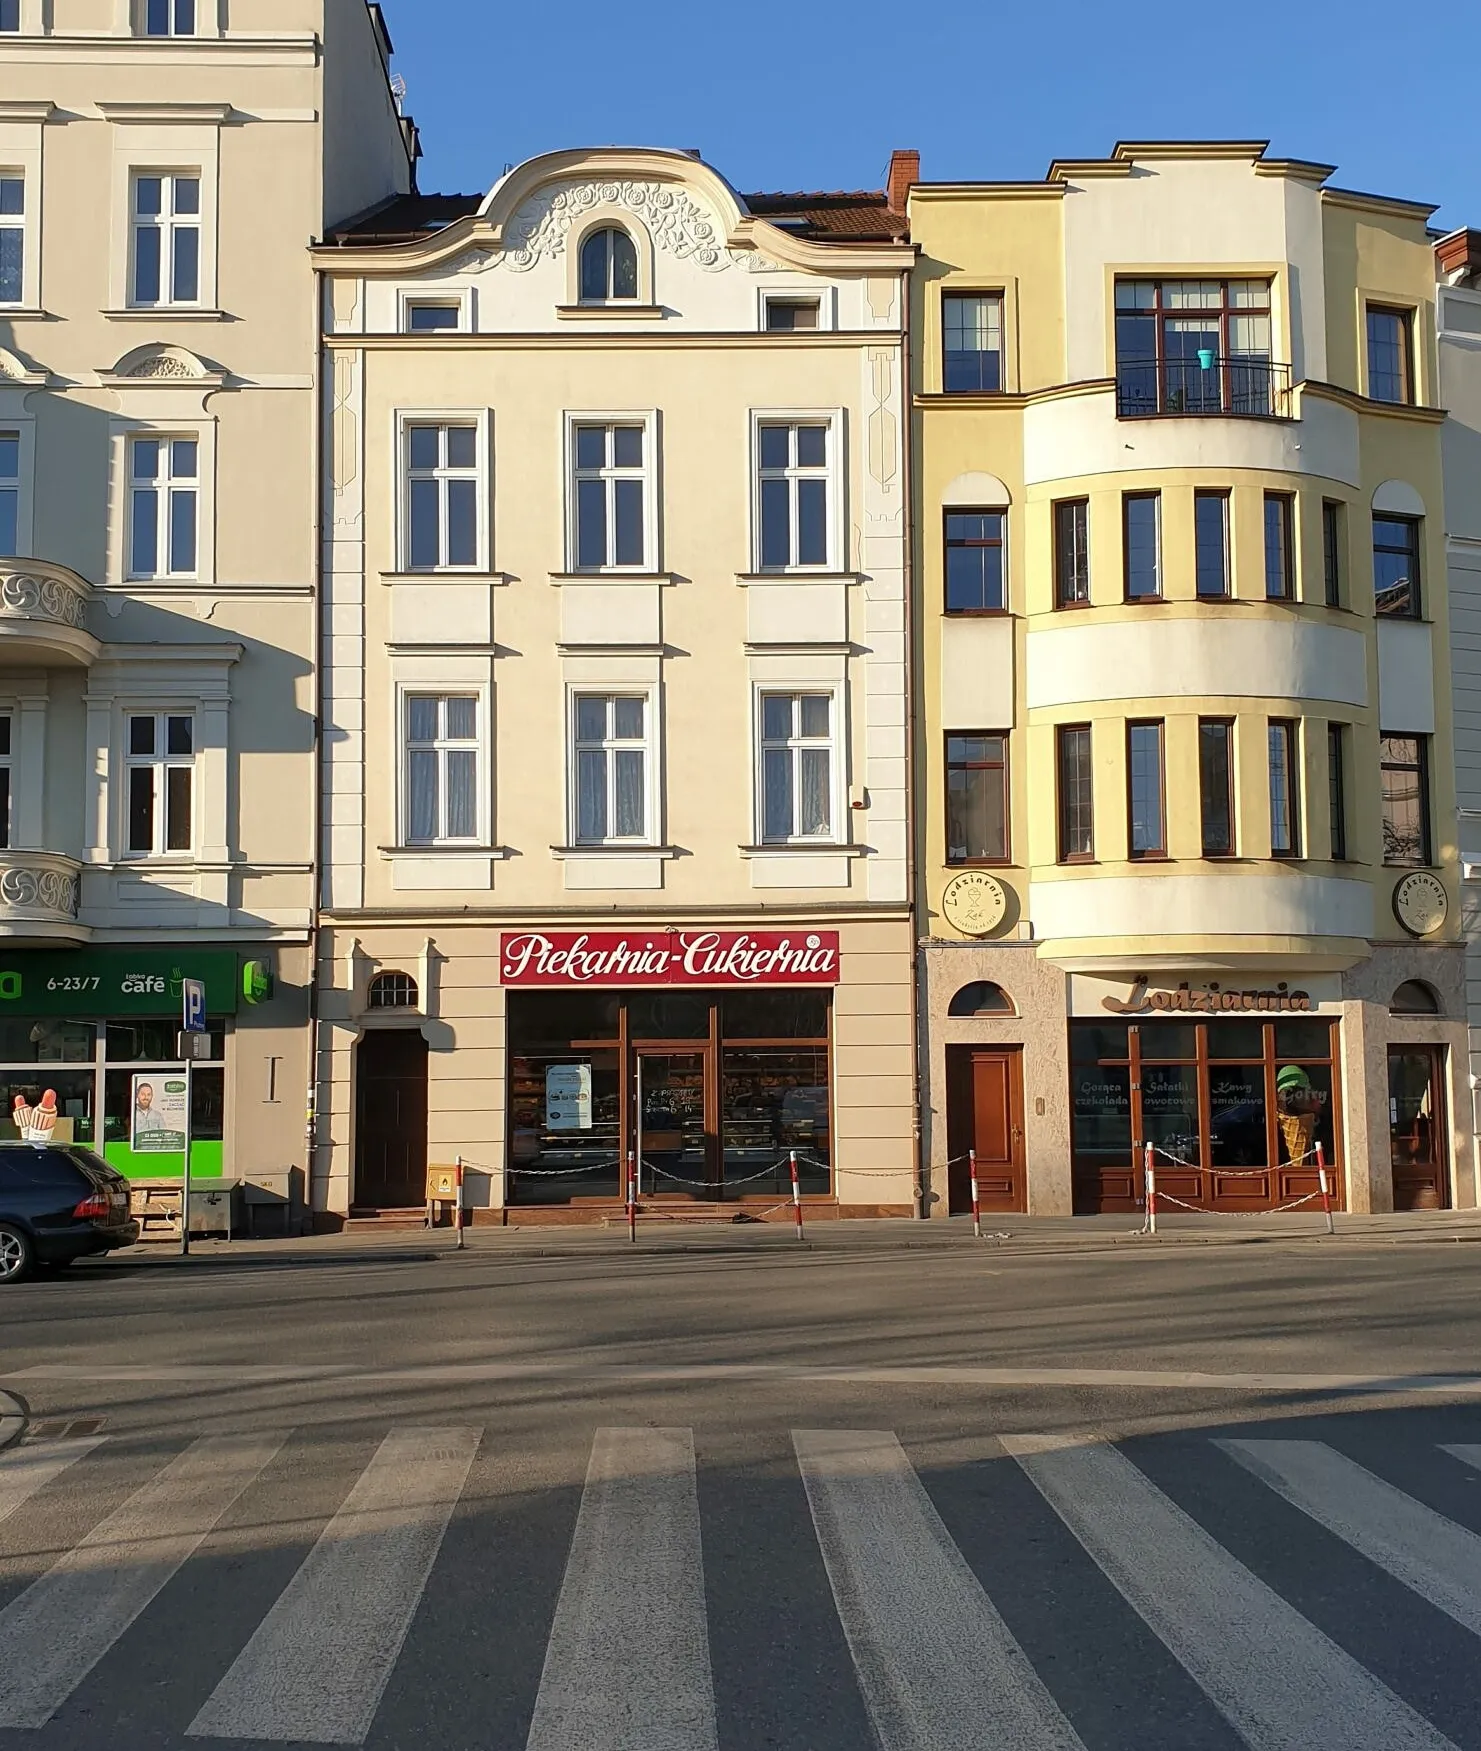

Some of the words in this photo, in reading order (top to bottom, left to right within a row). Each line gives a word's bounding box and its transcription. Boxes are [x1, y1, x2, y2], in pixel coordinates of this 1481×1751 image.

[946, 875, 1002, 906] Lodziarnia
[1399, 875, 1444, 906] Lodziarnia
[503, 933, 836, 981] Piekarnia-Cukiernia
[47, 977, 100, 991] 6-23/7
[121, 975, 165, 993] café
[1101, 975, 1311, 1014] Lodziarnia
[189, 985, 201, 1025] P
[1211, 1081, 1253, 1094] Kawy
[1280, 1086, 1328, 1105] Gofry
[1075, 1096, 1128, 1105] czekolada
[1144, 1097, 1196, 1105] owocowe
[1211, 1096, 1264, 1105] smakowe
